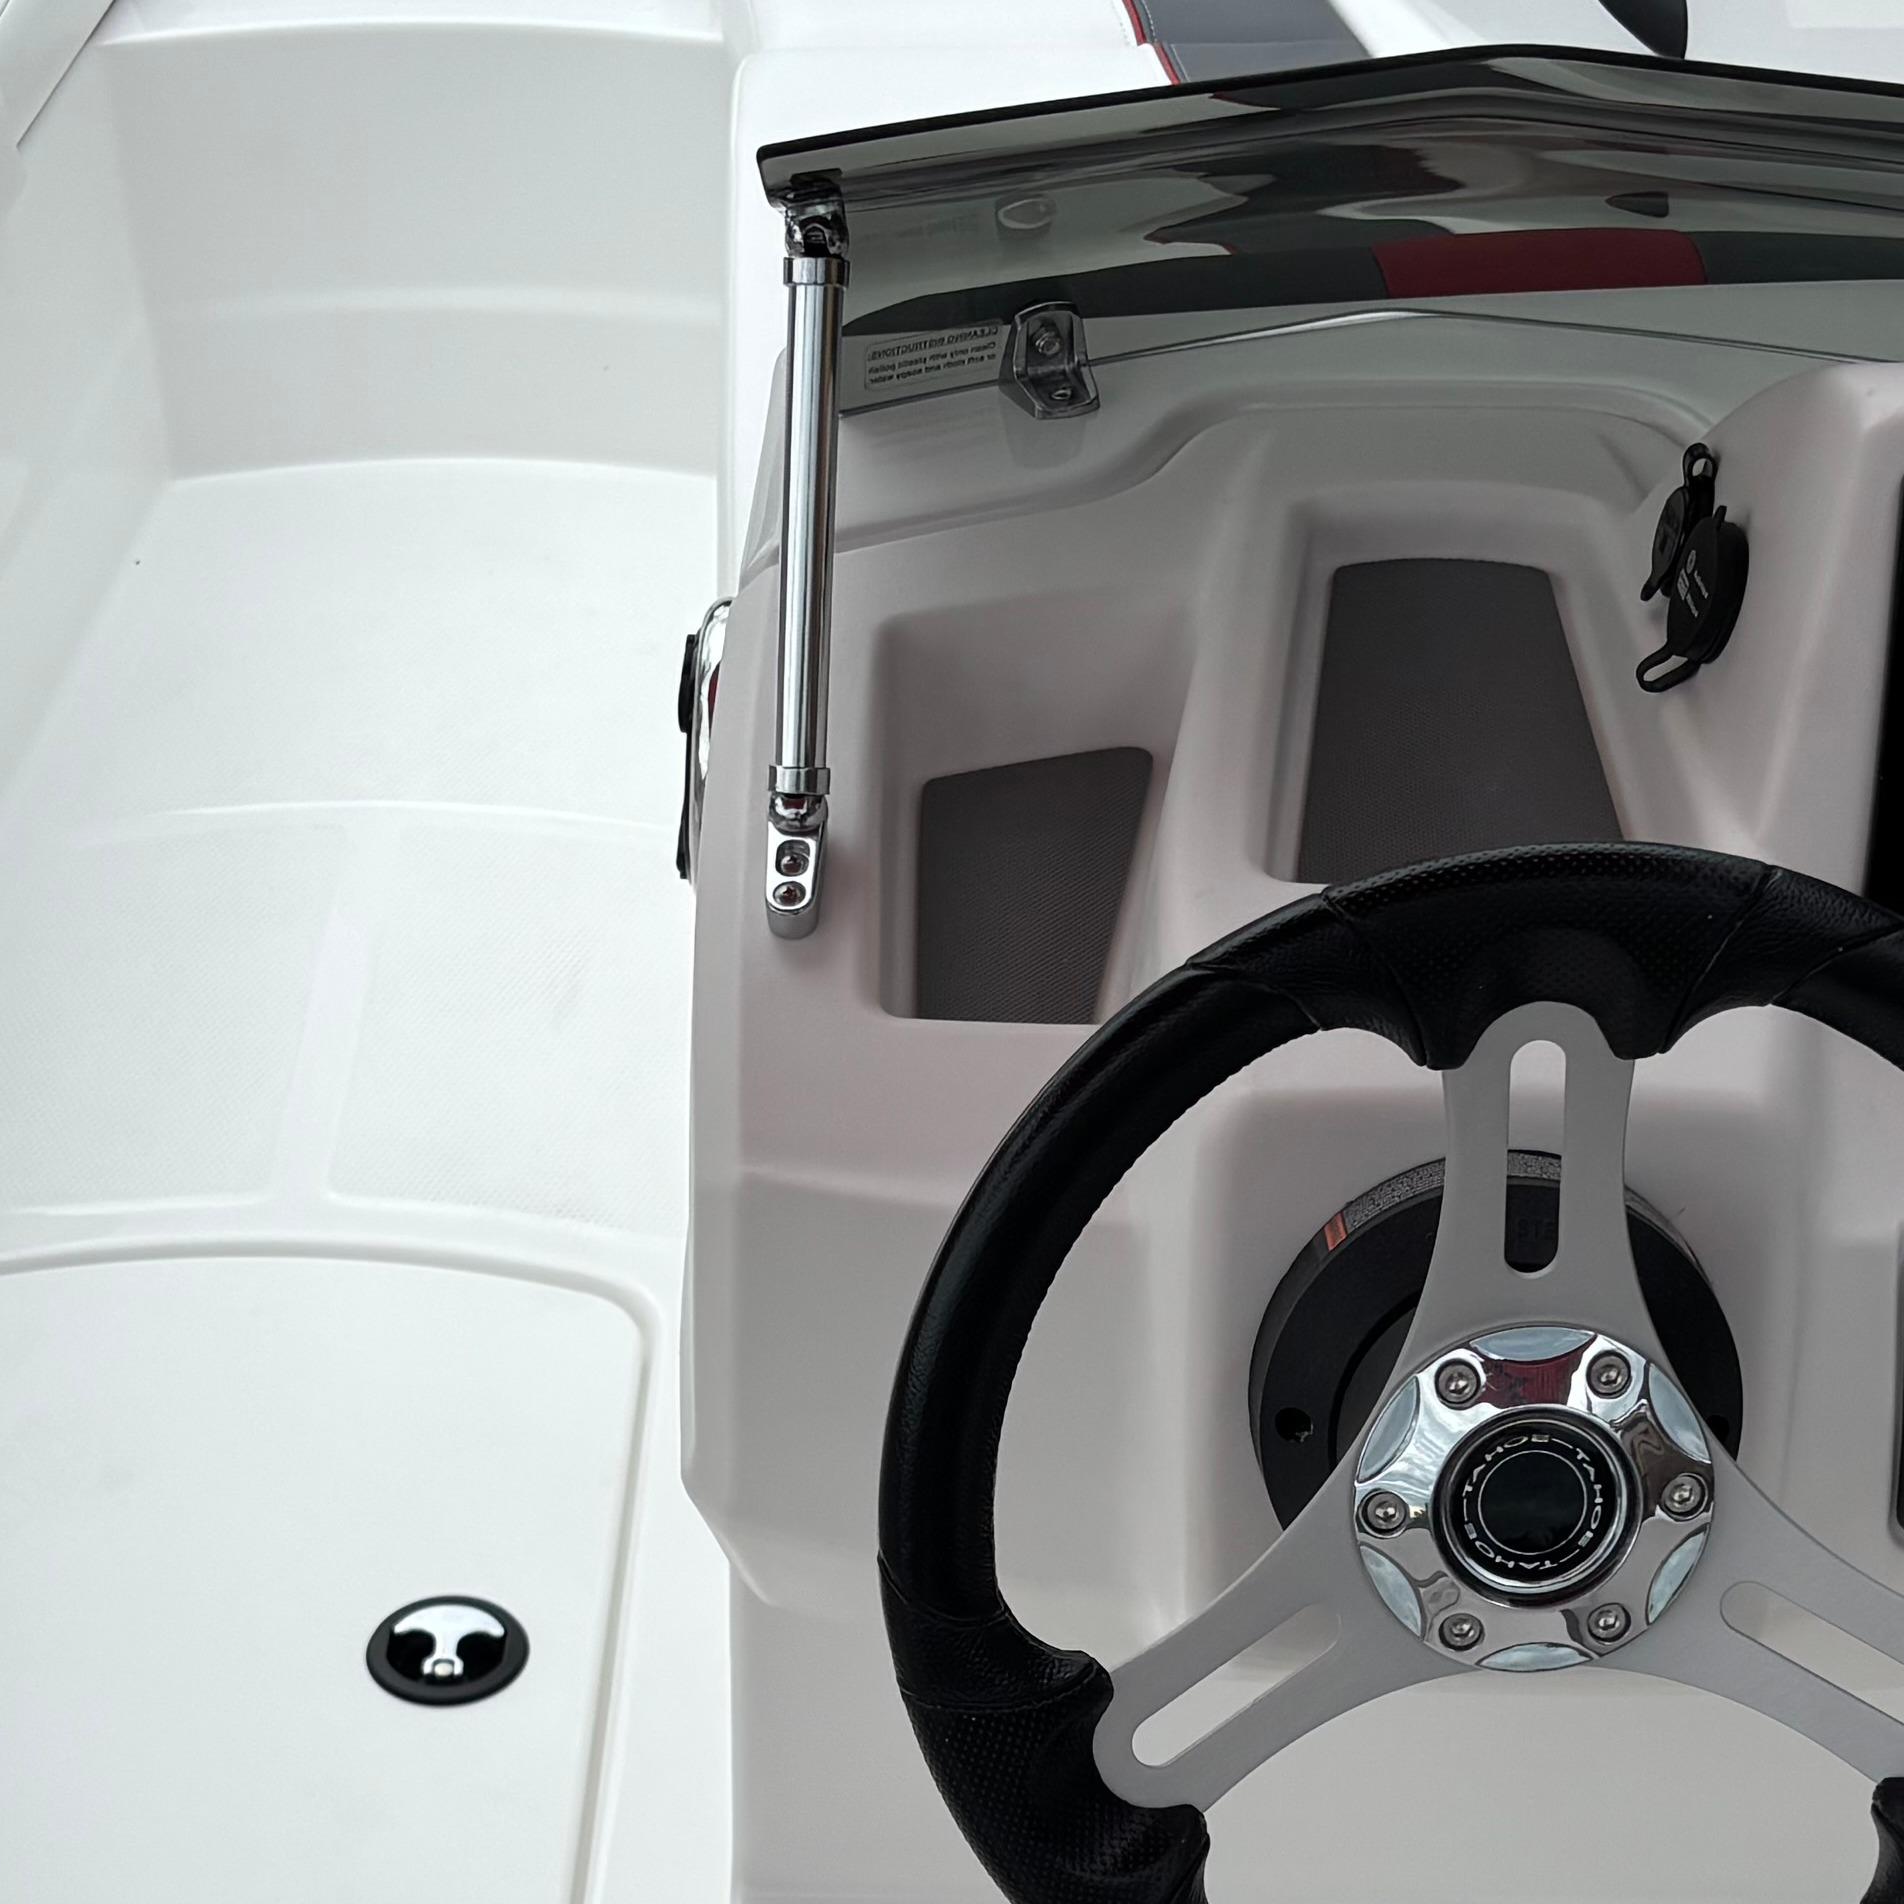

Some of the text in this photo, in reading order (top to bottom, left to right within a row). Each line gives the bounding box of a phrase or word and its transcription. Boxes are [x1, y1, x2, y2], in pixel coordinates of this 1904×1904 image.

[1463, 1433, 1550, 1494] TAHOE
[1576, 1447, 1603, 1549] TAHOE
[1464, 1523, 1558, 1569] TAHOE
